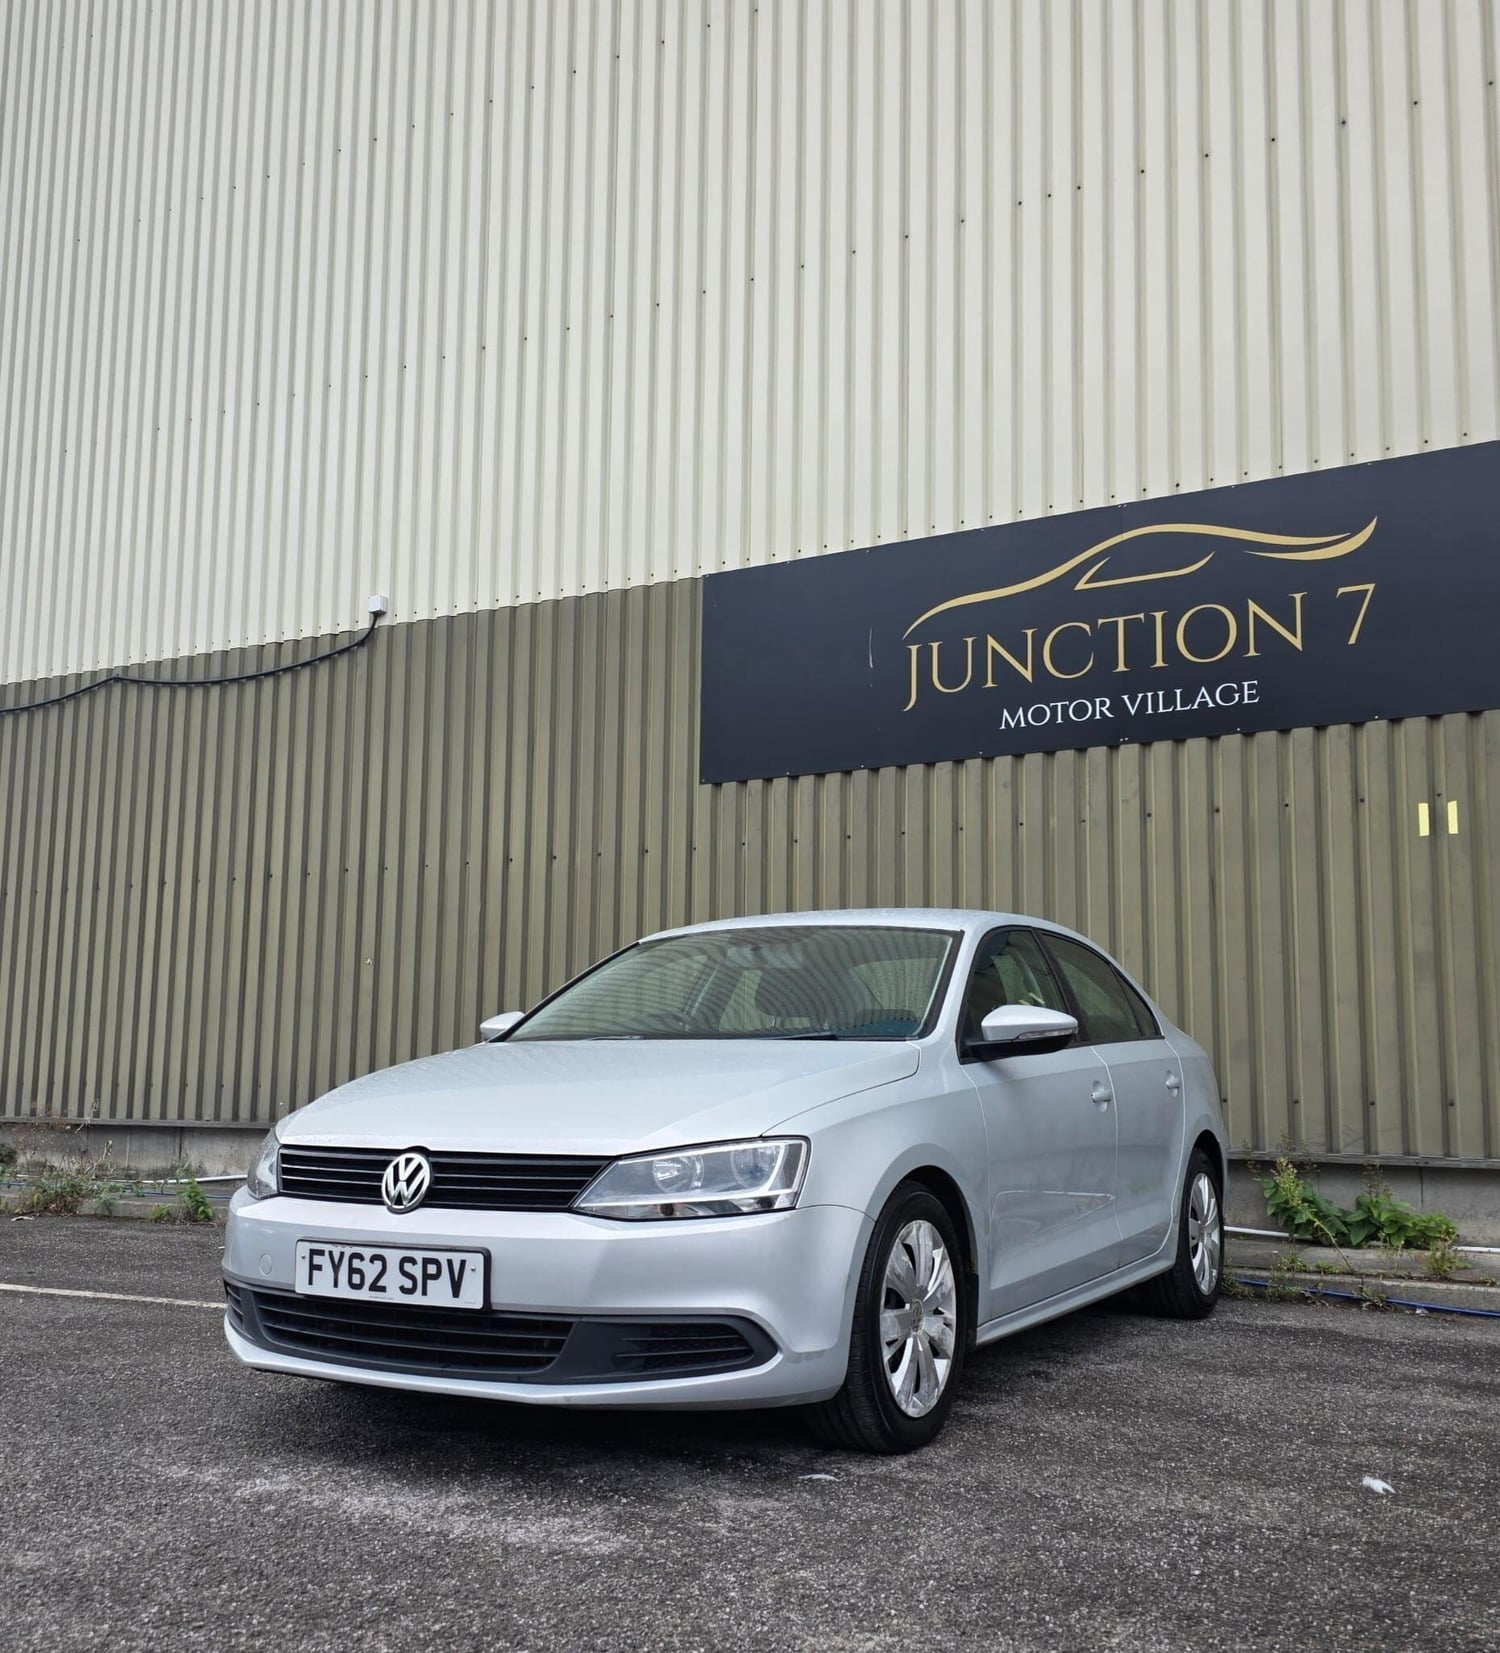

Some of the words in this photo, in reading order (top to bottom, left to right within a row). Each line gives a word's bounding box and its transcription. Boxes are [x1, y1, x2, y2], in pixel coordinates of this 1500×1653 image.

[904, 592, 1307, 711] JUNCTION
[1336, 583, 1376, 645] 7
[1000, 697, 1113, 730] MOTOR
[1121, 681, 1260, 717] VILLAGE
[382, 1153, 430, 1210] VW
[308, 1248, 387, 1293] FY62
[398, 1256, 467, 1299] SPV
